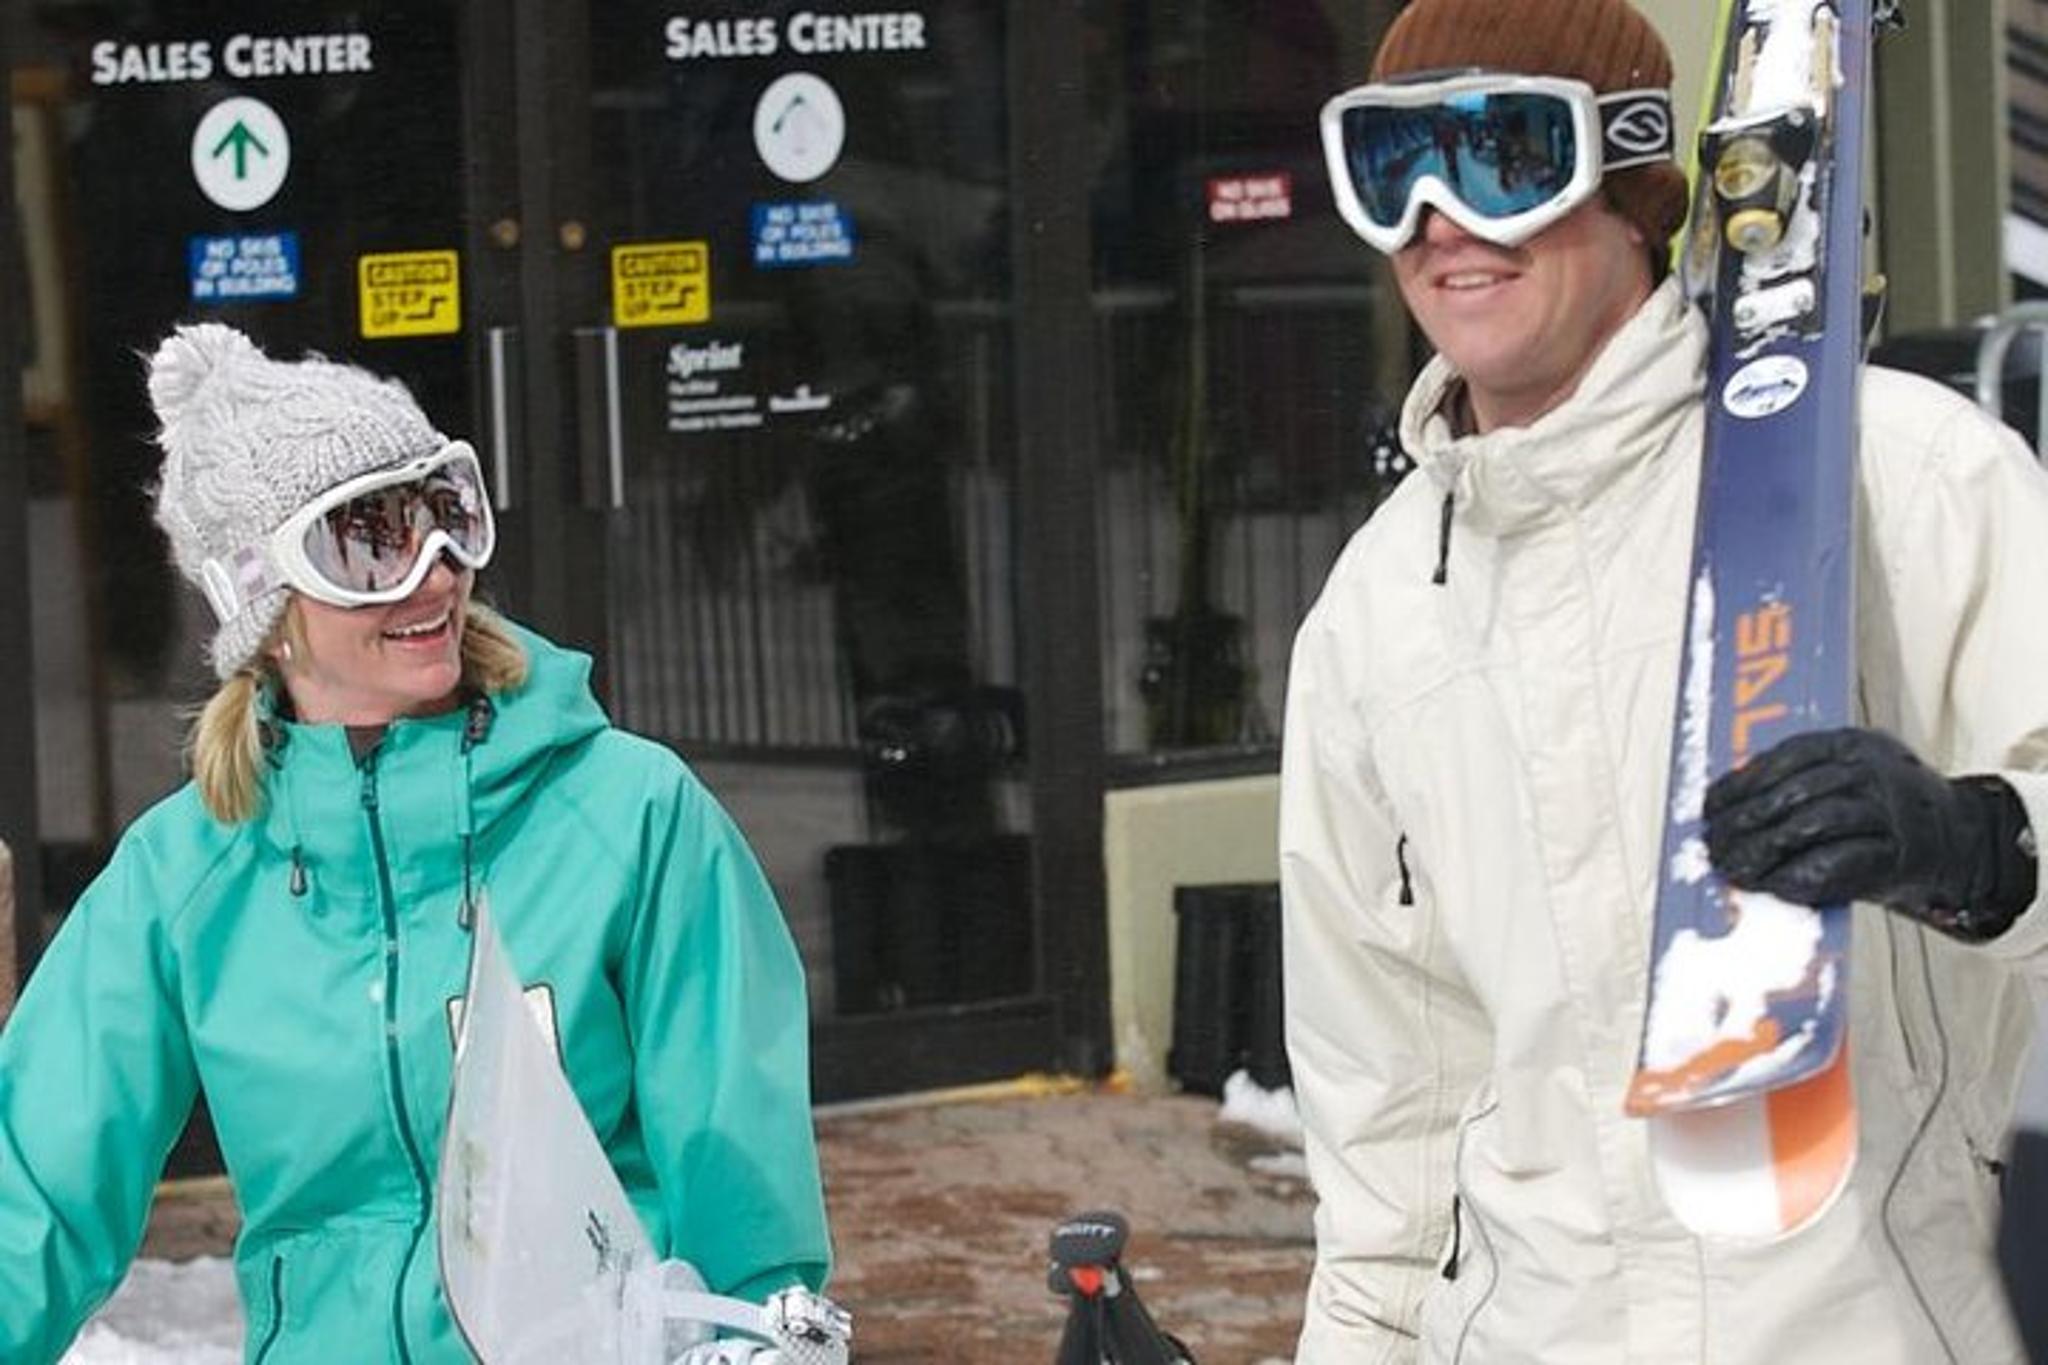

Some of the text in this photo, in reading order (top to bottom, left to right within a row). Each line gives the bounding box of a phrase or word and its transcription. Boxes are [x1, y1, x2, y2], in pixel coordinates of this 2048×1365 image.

[665, 12, 926, 59] SALES CENTER
[91, 34, 374, 84] SALES CENTER
[370, 290, 425, 310] STEP
[624, 279, 676, 300] STEP
[667, 341, 743, 378] Sprint
[1731, 600, 1794, 772] SAL
